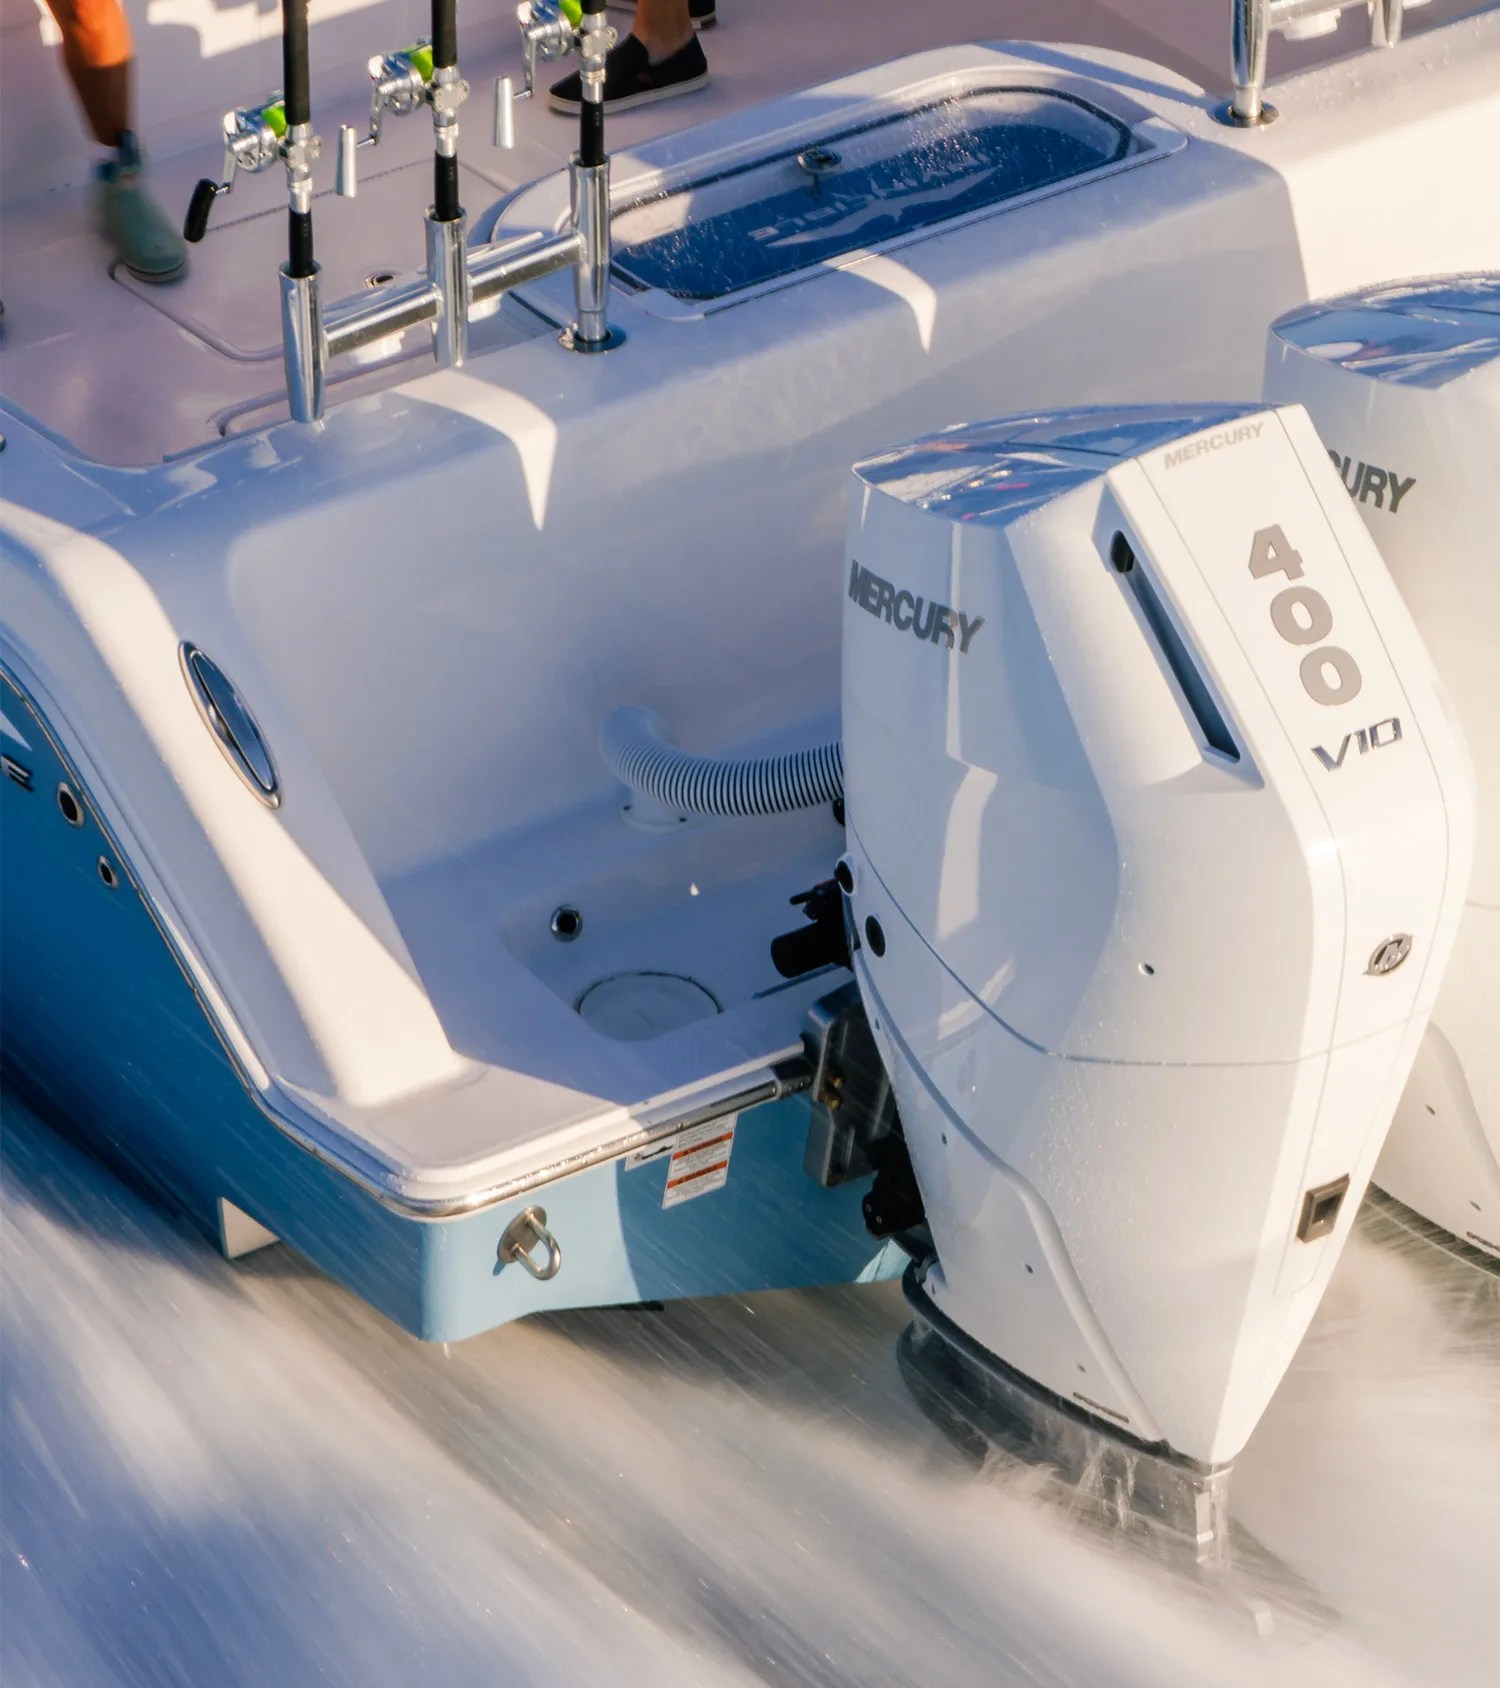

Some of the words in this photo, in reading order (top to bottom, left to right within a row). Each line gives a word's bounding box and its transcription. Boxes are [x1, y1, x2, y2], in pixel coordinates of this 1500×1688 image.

[1164, 422, 1264, 470] MERCURY
[848, 558, 986, 656] MERCURY
[1248, 524, 1363, 706] 400
[1311, 717, 1403, 772] V10
